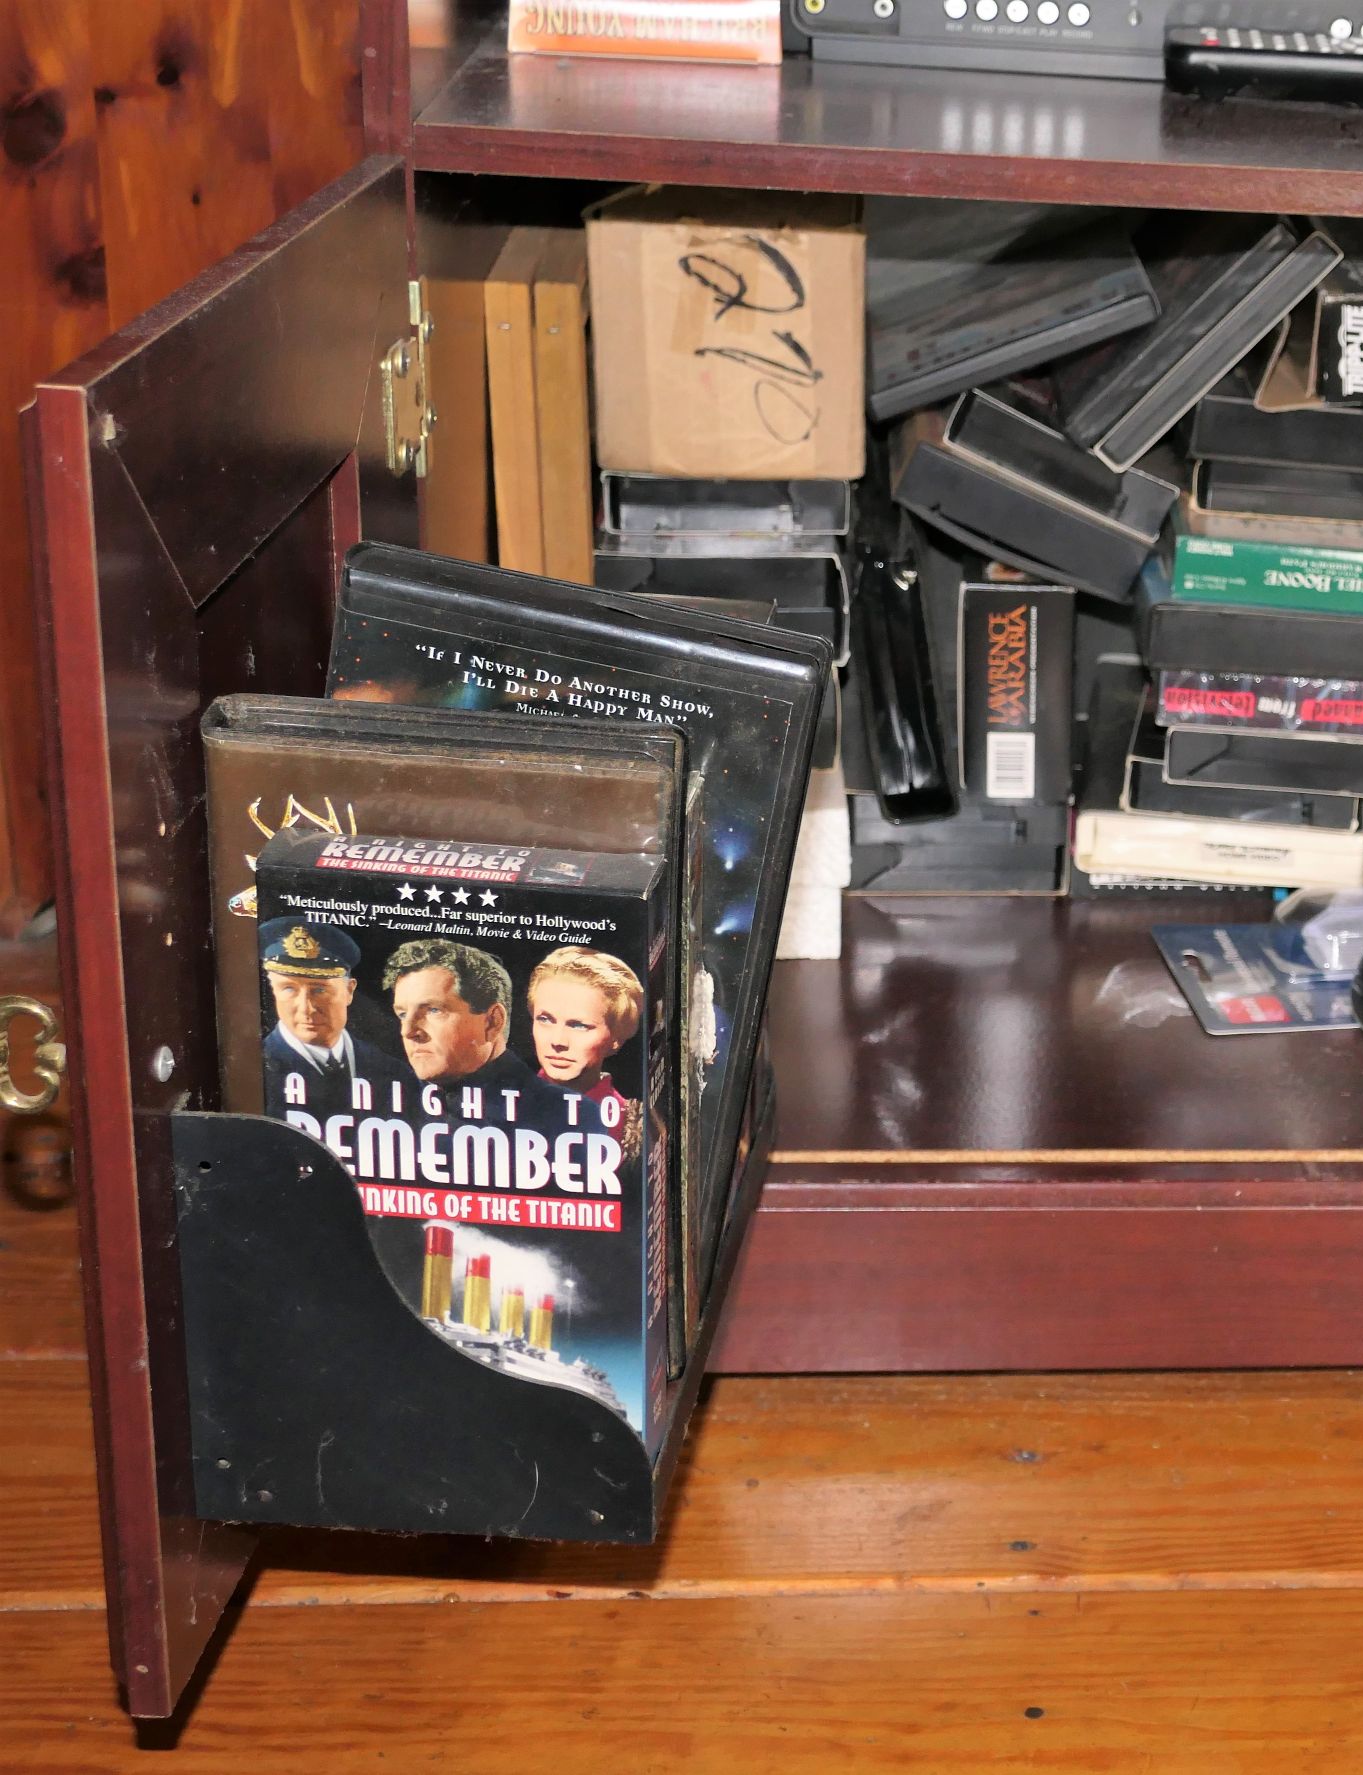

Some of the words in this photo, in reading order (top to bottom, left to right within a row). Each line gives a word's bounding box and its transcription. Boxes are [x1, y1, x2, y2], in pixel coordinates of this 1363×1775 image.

[525, 6, 624, 37] YOUNG
[1263, 570, 1331, 593] BOONE
[453, 652, 461, 664] I
[987, 612, 1009, 723] LAWRENCE
[1007, 603, 1027, 708] ARABIA
[546, 690, 559, 702] A
[1257, 695, 1296, 718] from
[321, 842, 526, 872] REMEMBER
[498, 848, 531, 857] TO
[323, 858, 350, 868] THE
[351, 860, 408, 873] SINKING
[410, 865, 429, 874] OF
[431, 867, 458, 877] THE
[461, 869, 517, 881] TITANIC
[279, 894, 369, 914] “Meticulously
[465, 911, 517, 925] superior
[519, 915, 533, 925] to
[535, 914, 617, 931] Hollywood’s
[435, 923, 474, 936] Maltin,
[476, 926, 509, 939] Movie
[512, 929, 522, 940] &
[526, 930, 556, 942] Video
[558, 933, 592, 945] Guide
[284, 1072, 306, 1105] A
[352, 1077, 520, 1122] NIGHT
[563, 1093, 621, 1128] TO
[358, 1187, 438, 1216] NKING
[444, 1193, 473, 1218] OF
[478, 1196, 520, 1223] THE
[526, 1199, 615, 1228] TITANIC
